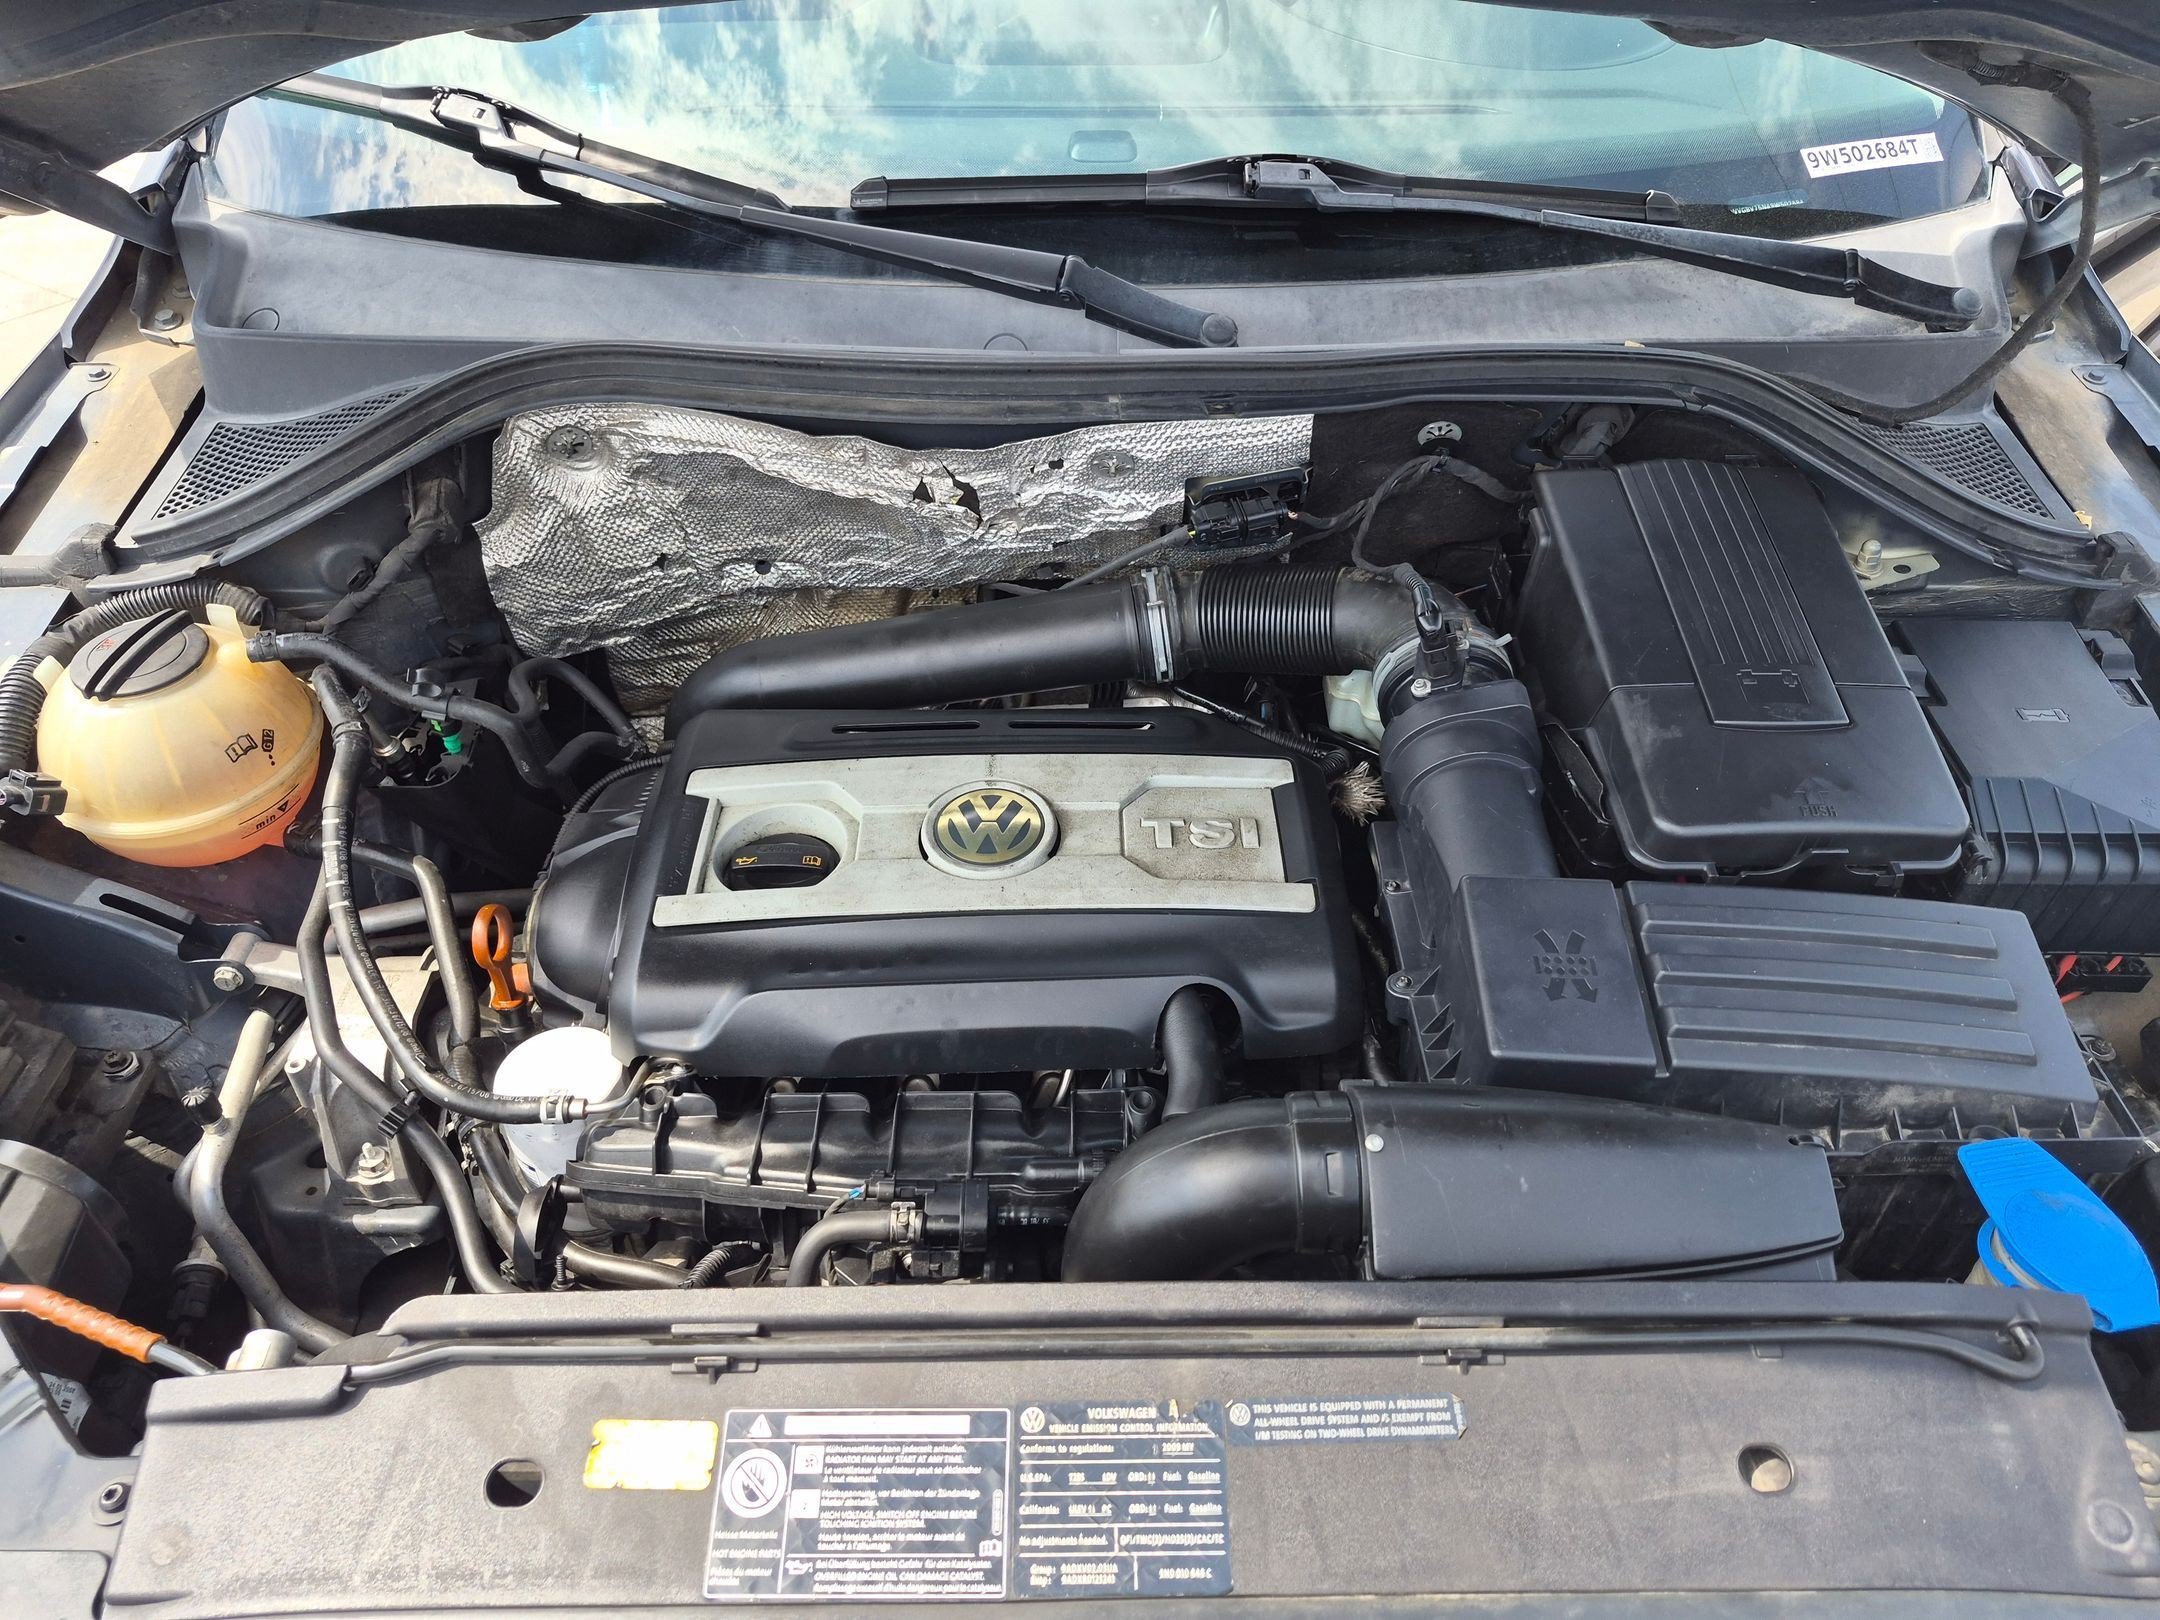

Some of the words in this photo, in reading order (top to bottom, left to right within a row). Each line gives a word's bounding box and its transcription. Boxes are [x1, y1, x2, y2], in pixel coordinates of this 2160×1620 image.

[1807, 138, 1918, 168] 9W502684T
[1798, 805, 1839, 817] PUSH
[256, 814, 276, 829] min
[1138, 816, 1262, 850] TSI
[1087, 1407, 1157, 1419] VOLKSWAGEN
[1252, 1404, 1272, 1414] THIS
[1274, 1403, 1308, 1413] VEHICLE
[1309, 1403, 1318, 1413] IS
[1320, 1401, 1361, 1412] EQUIPPED
[1363, 1401, 1386, 1411] WITH
[1388, 1400, 1396, 1409] A
[1397, 1399, 1448, 1409] PERMANENT
[1254, 1416, 1299, 1427] ALL-WHEEL
[1300, 1416, 1325, 1426] DRIVE
[1327, 1415, 1358, 1425] SYSTEM
[1360, 1413, 1380, 1424] AND
[1381, 1413, 1390, 1423] IS
[1391, 1413, 1424, 1423] EXEMPT
[1426, 1412, 1451, 1422] FROM
[1271, 1429, 1302, 1441] TESTING
[1303, 1429, 1317, 1439] ON
[1318, 1427, 1365, 1438] TWO-WHEEL
[1366, 1427, 1389, 1437] DRIVE
